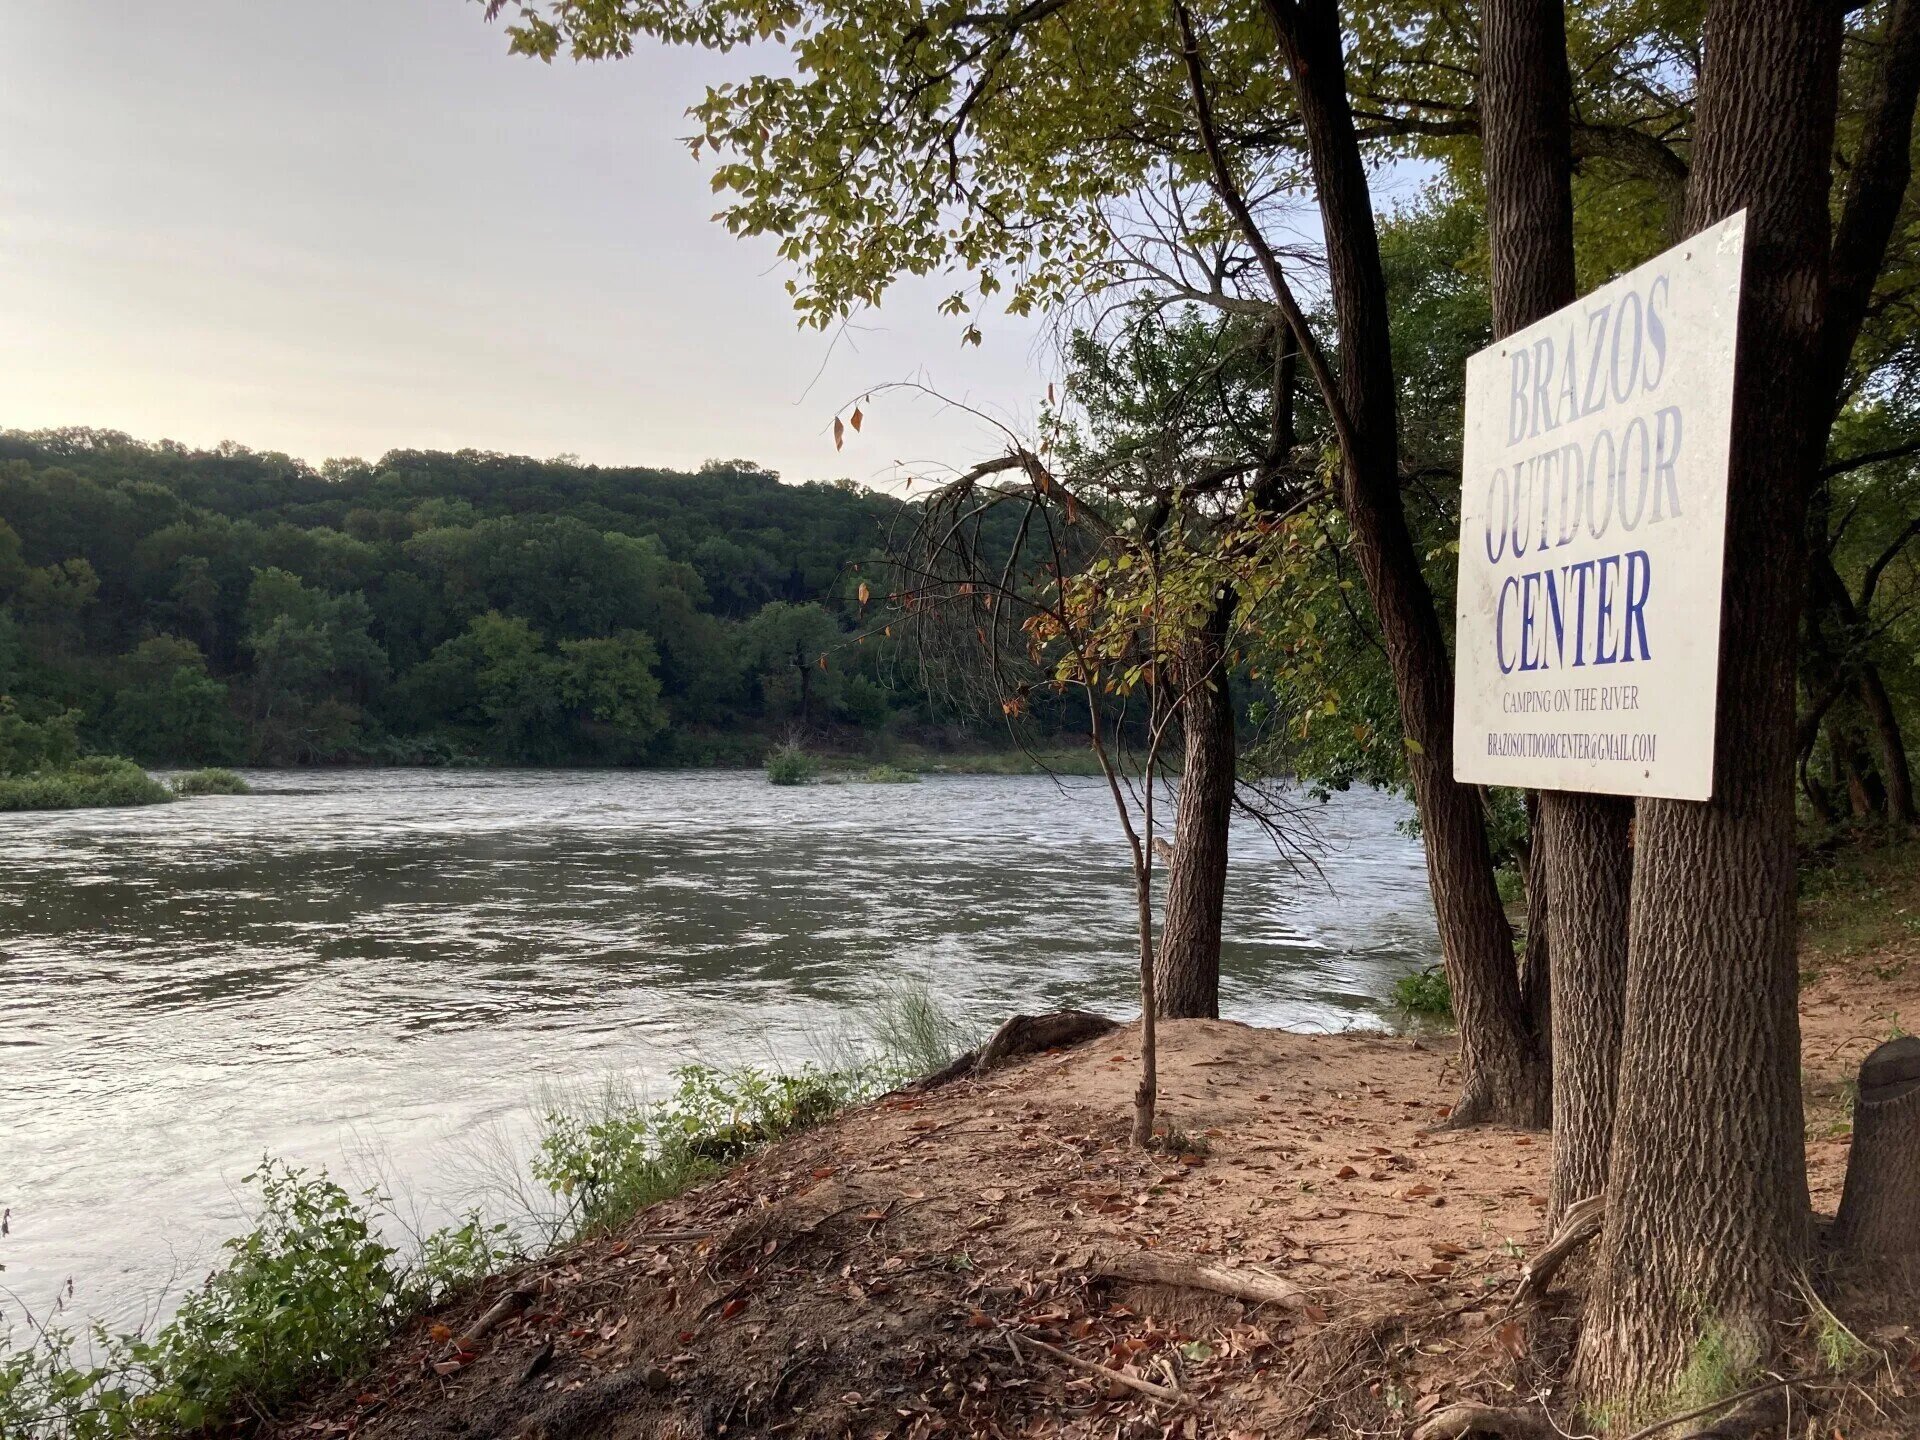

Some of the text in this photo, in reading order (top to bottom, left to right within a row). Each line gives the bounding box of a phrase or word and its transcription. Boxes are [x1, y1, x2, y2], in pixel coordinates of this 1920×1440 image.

[1506, 270, 1670, 448] BRAZOS
[1485, 405, 1683, 564] OUTDOOR
[1496, 550, 1651, 675] CENTER
[1487, 732, 1657, 767] BRAZOSOUTDOORCENTER@GMAIL.COM
[1503, 685, 1639, 713] CAMPING ON THE RIVER
